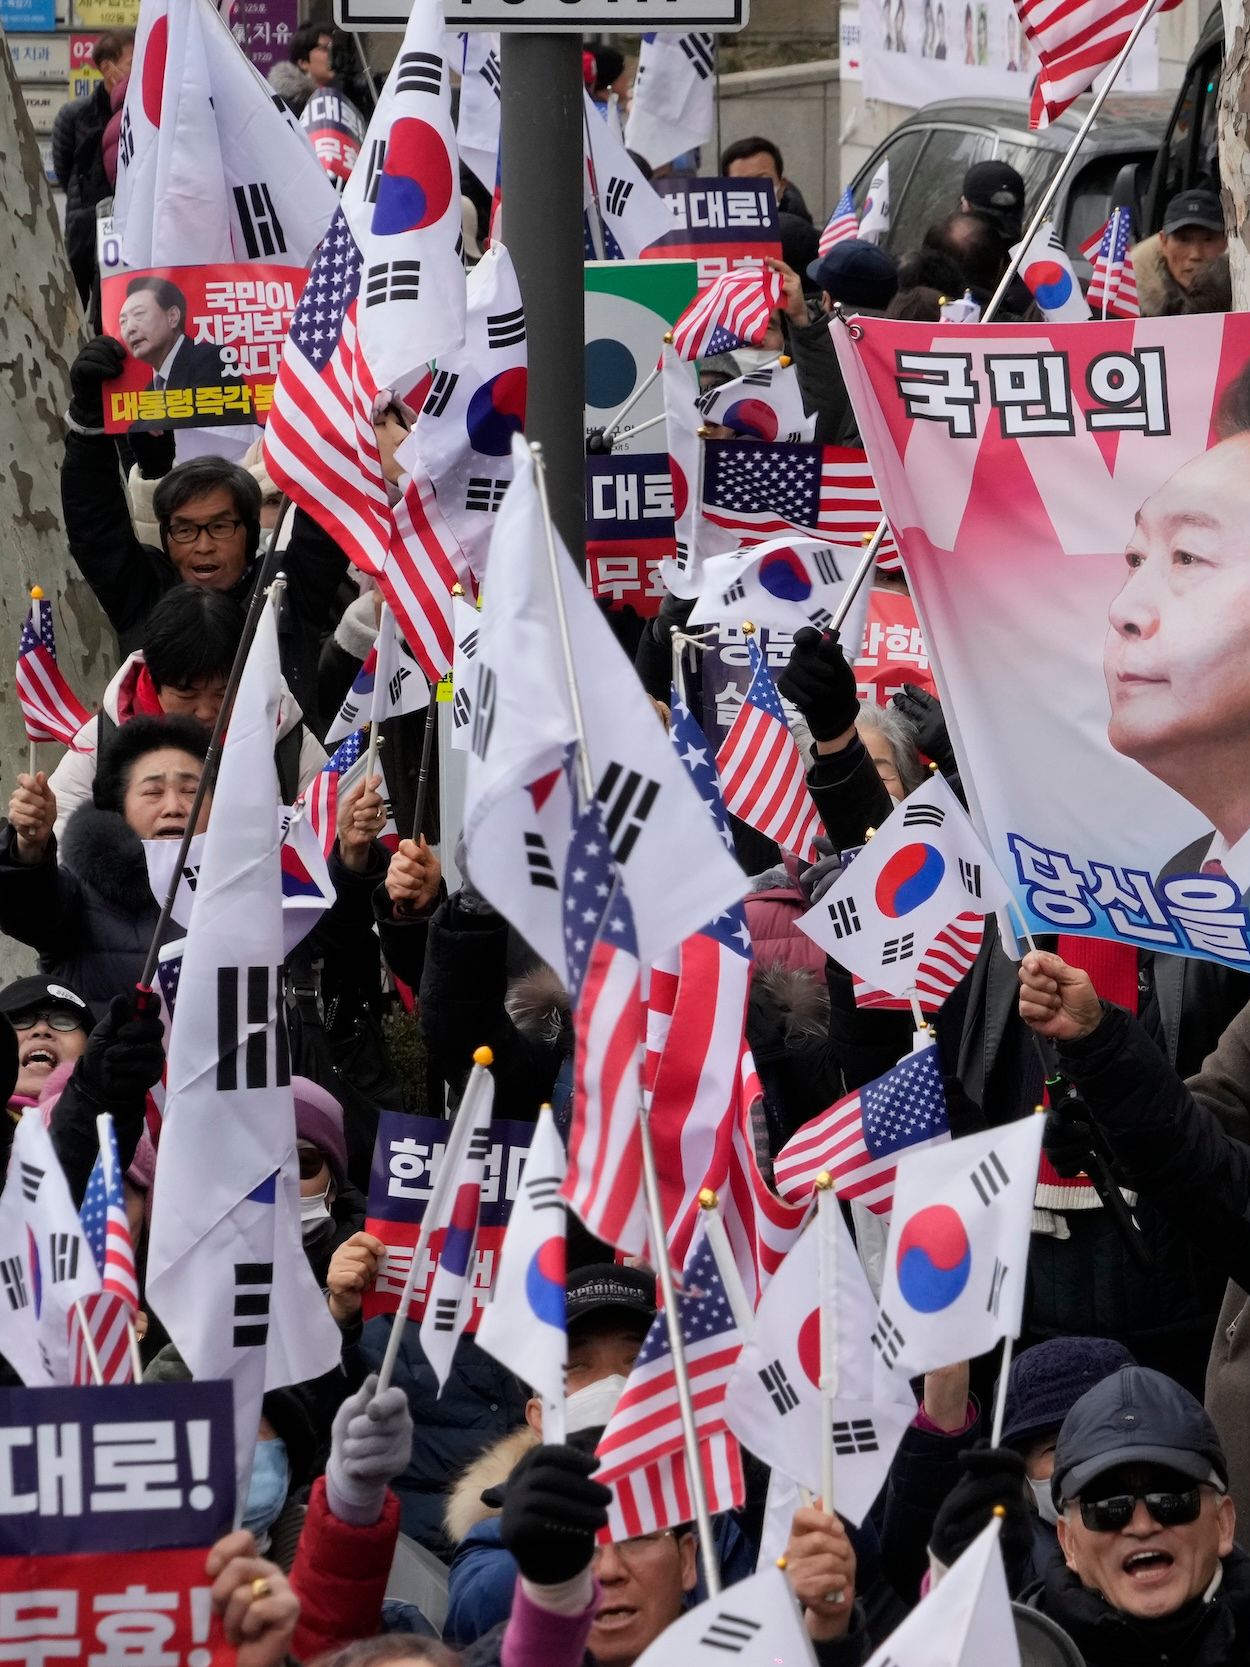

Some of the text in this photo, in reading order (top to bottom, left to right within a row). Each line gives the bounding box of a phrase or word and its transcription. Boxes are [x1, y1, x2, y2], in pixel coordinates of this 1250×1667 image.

[205, 281, 296, 313] 국민이
[111, 387, 194, 421] 대통령
[195, 384, 252, 415] 즉각
[894, 346, 1171, 439] 국민의
[566, 1284, 644, 1300] XPERIENCE
